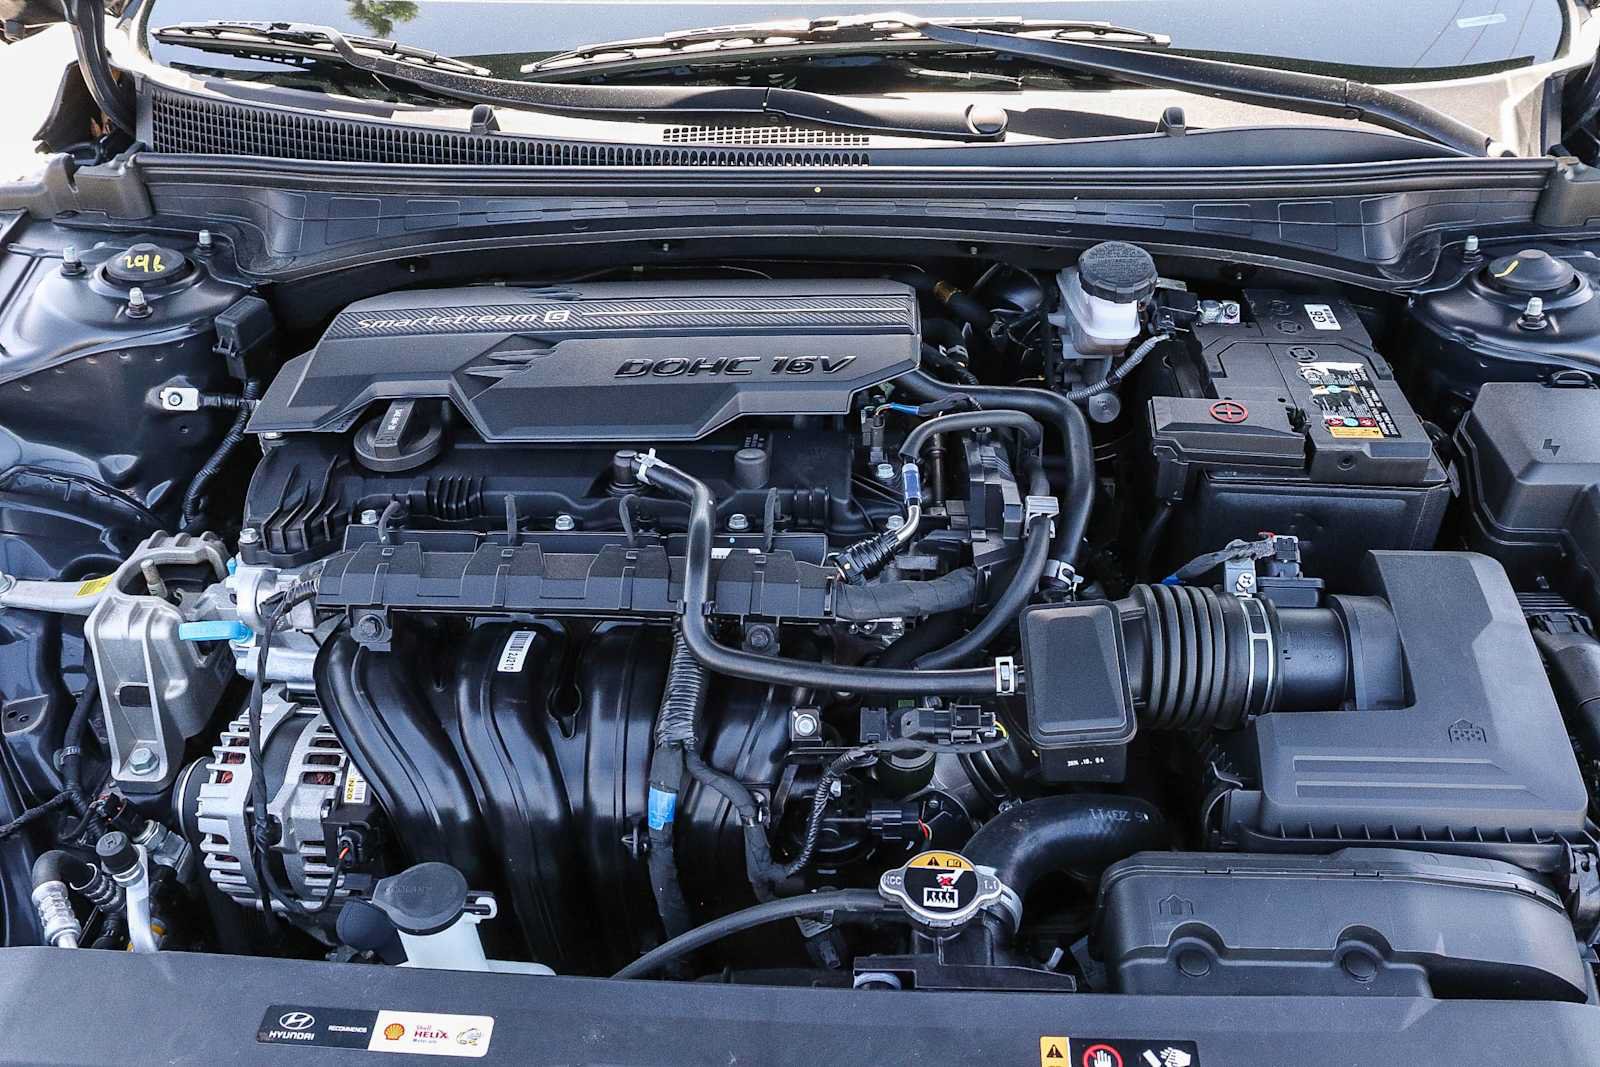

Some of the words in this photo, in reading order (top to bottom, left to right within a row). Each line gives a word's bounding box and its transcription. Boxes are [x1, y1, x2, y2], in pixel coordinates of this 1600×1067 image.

[351, 312, 539, 330] Smartstream
[613, 356, 761, 379] DOHC
[770, 355, 857, 376] 16V
[268, 1030, 315, 1041] HYUNDAI
[414, 1030, 448, 1039] HELIX
